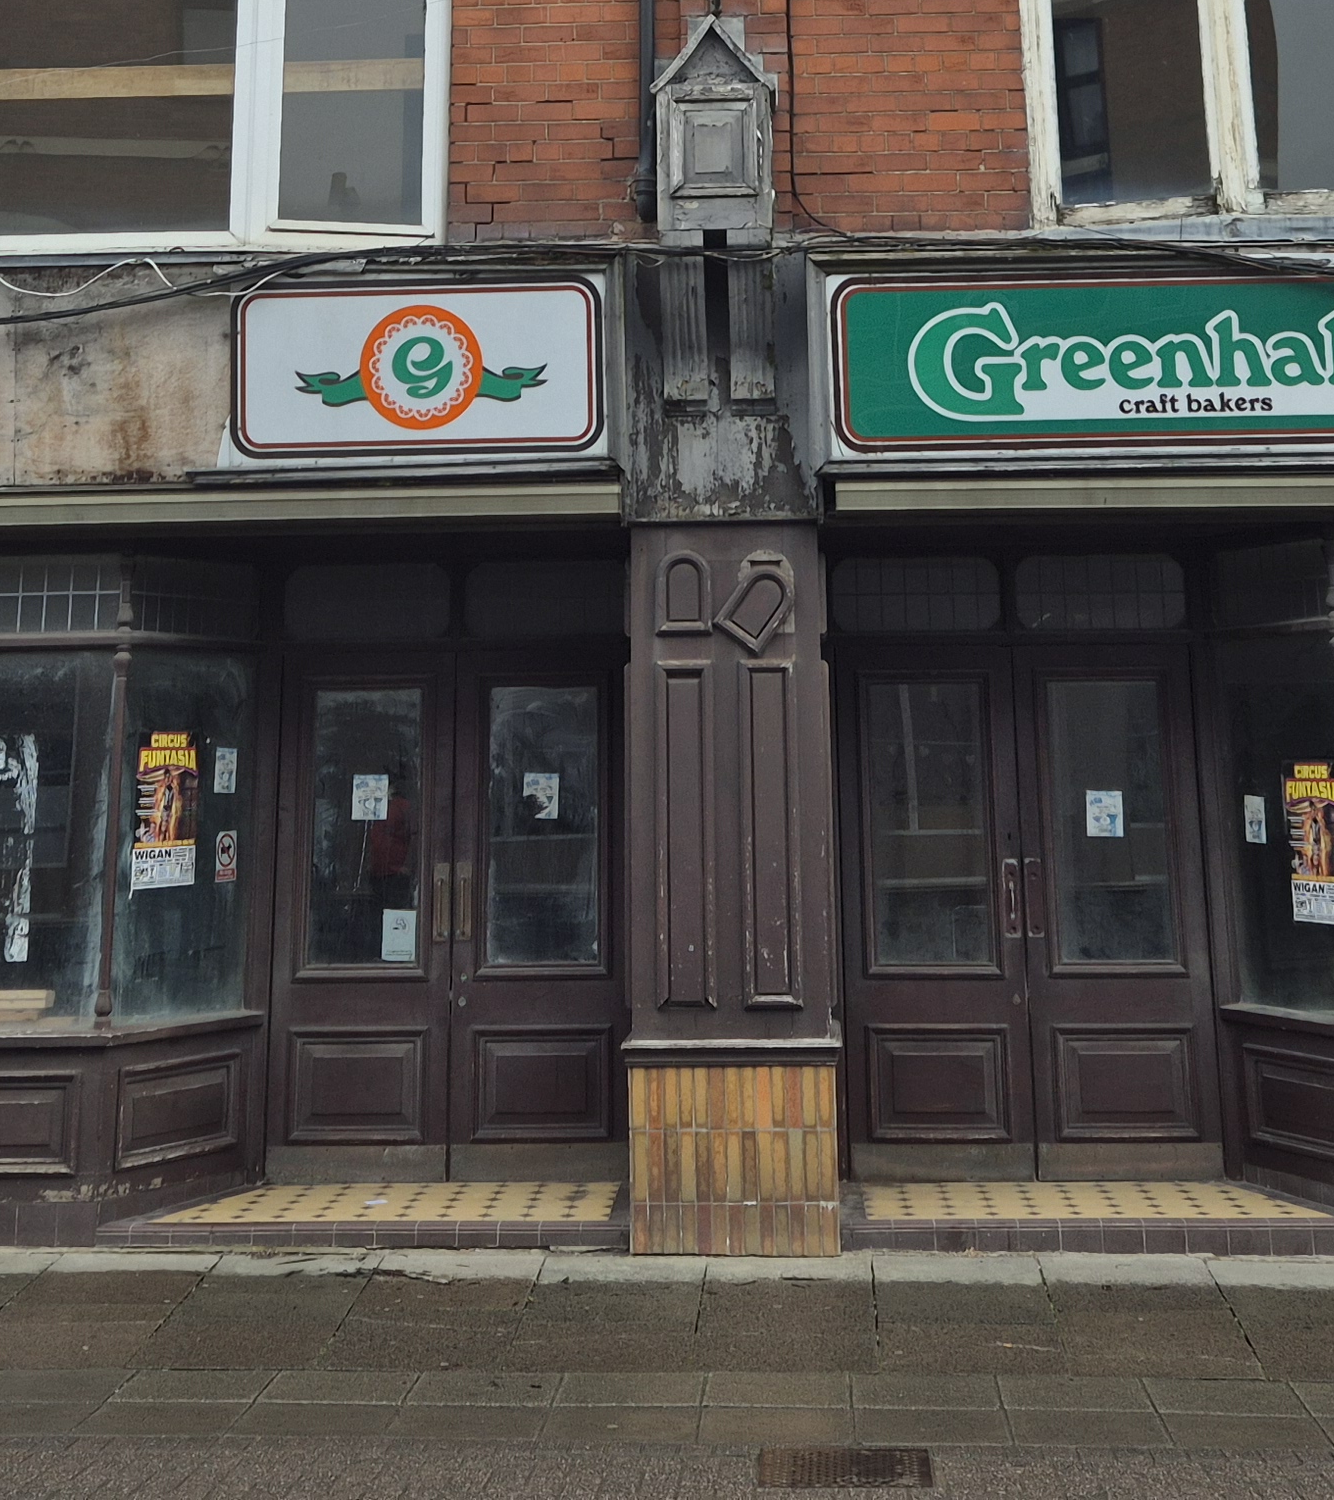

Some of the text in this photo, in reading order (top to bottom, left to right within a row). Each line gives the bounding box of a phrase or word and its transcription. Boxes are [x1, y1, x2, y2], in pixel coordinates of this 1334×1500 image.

[1119, 392, 1273, 415] craft bakers
[151, 733, 188, 748] CIRCUS
[139, 749, 197, 772] FUNTASIA
[1294, 765, 1328, 779] CIRCUS
[134, 849, 172, 861] WIGAN
[1293, 882, 1325, 894] WIGAN
